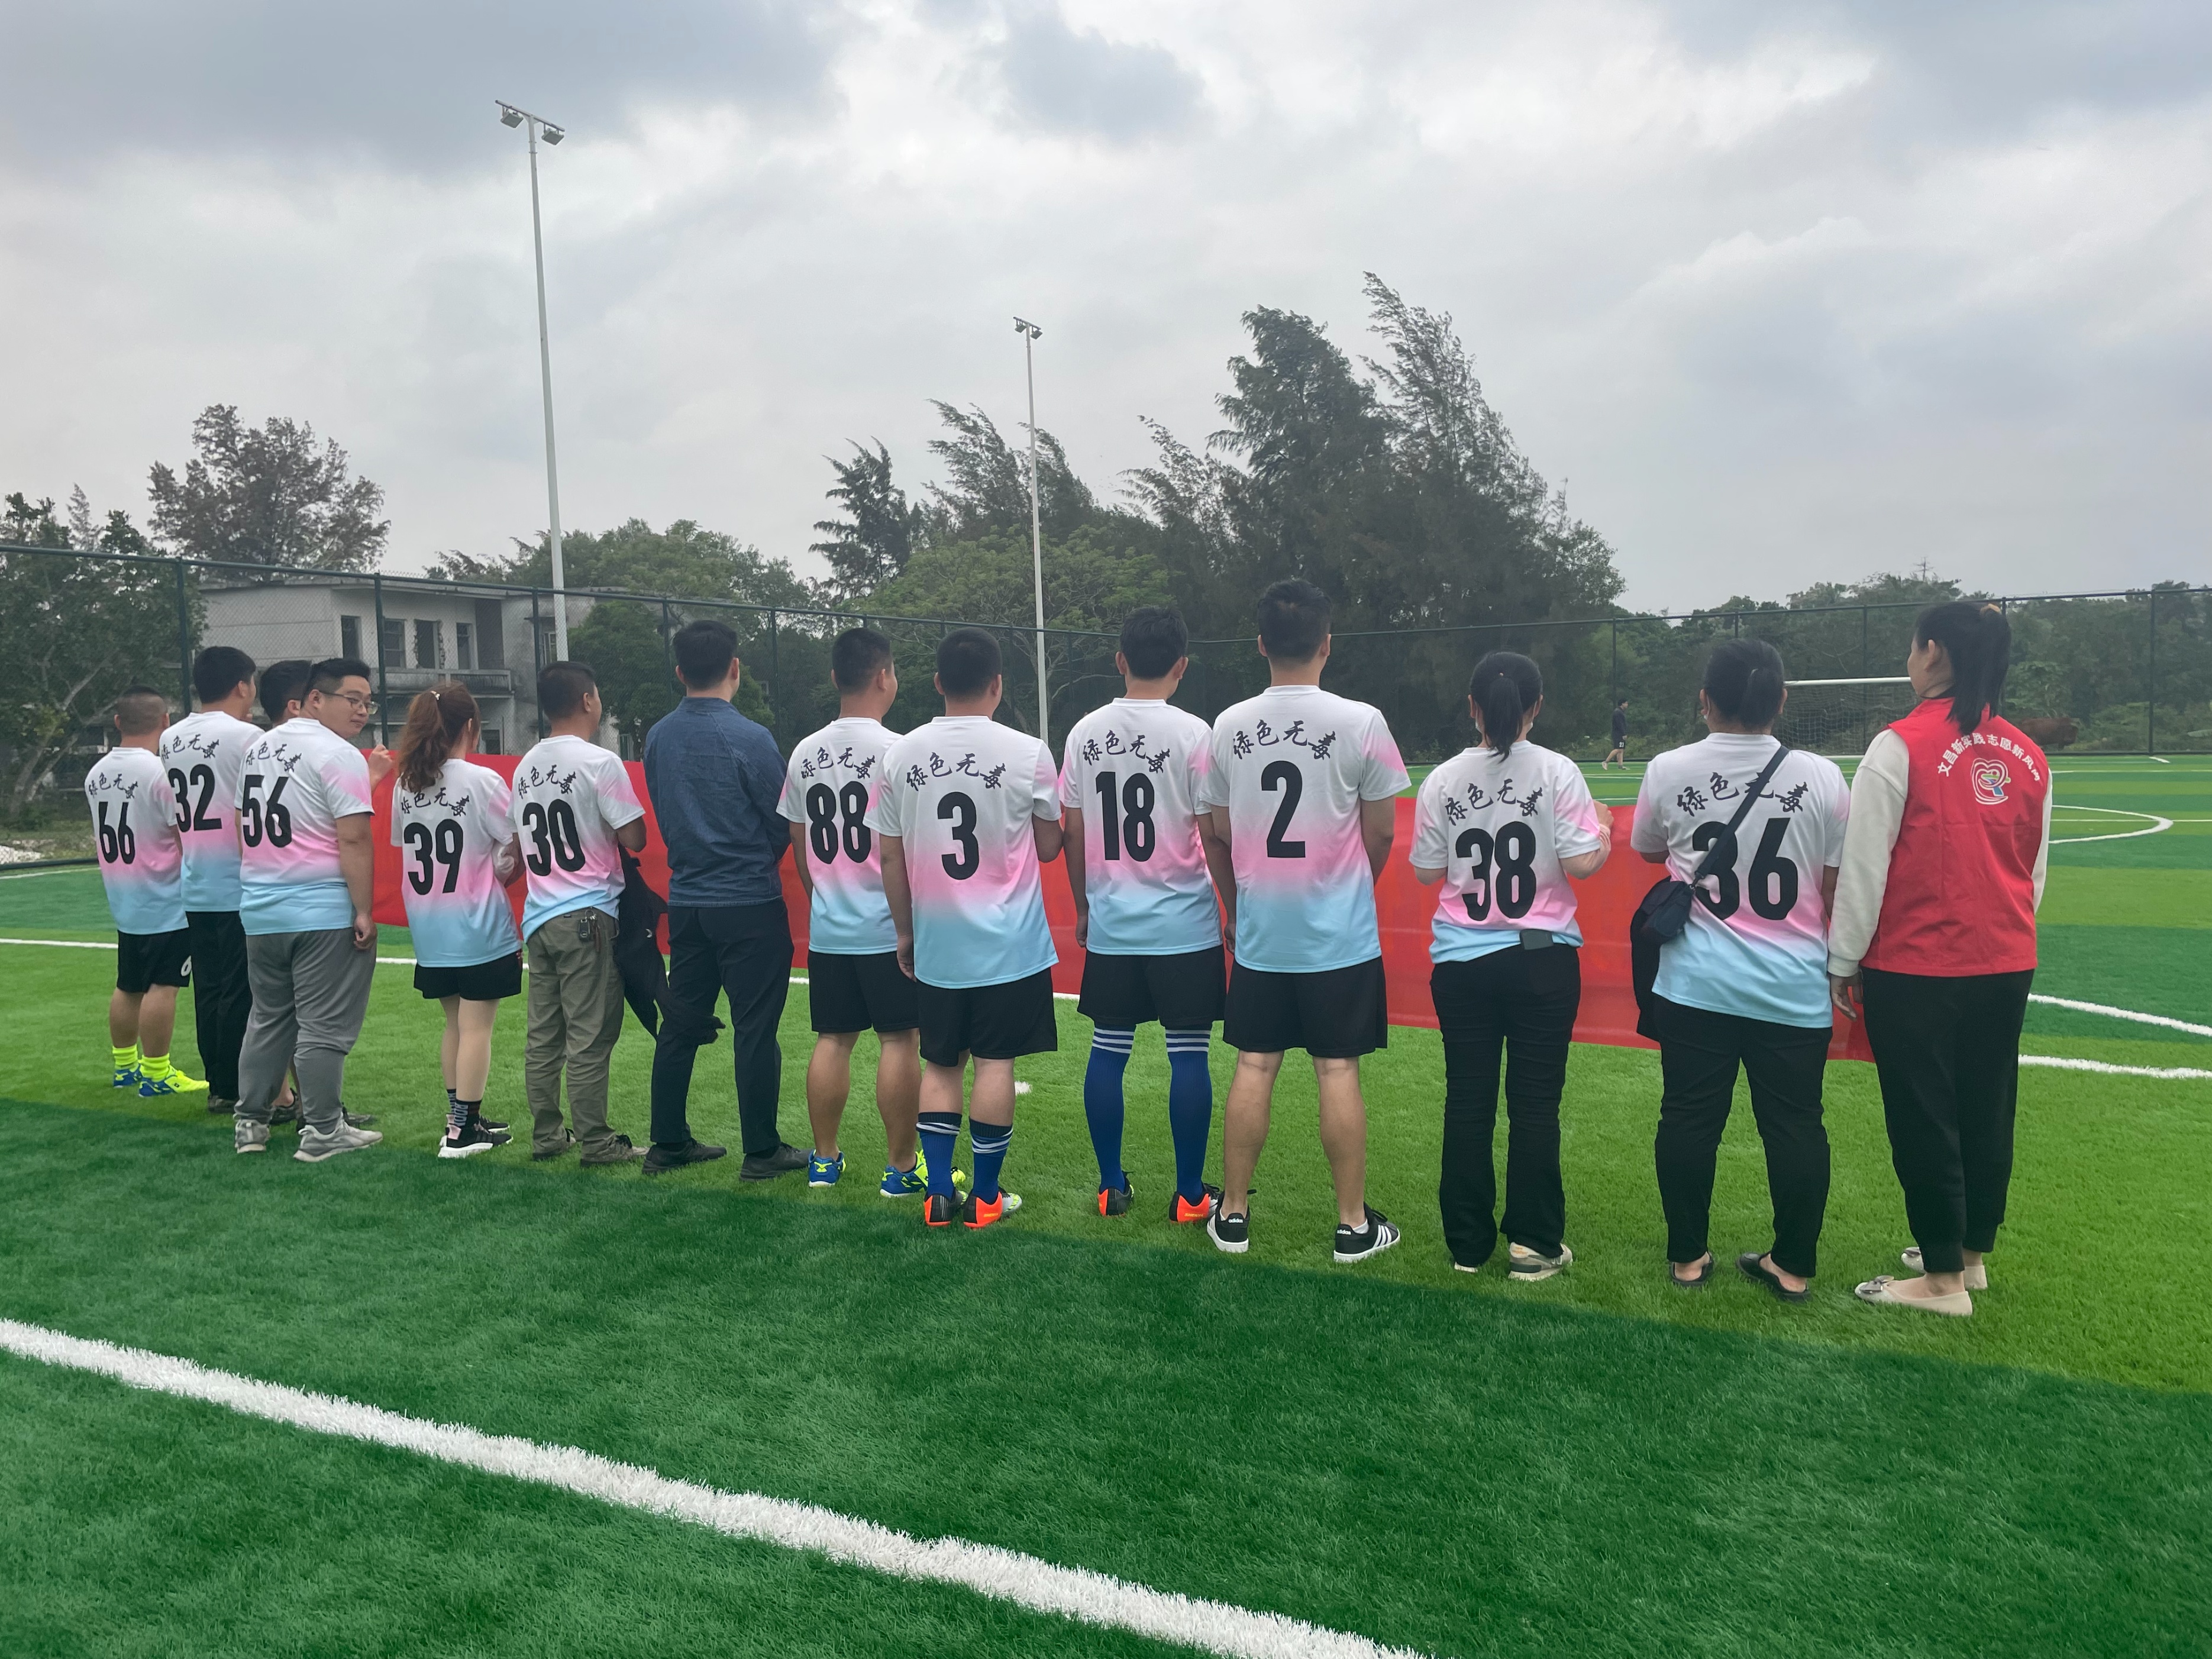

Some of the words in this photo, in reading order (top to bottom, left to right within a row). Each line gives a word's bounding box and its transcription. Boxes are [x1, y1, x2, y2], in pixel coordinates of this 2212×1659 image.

[98, 801, 135, 864] 66
[168, 764, 222, 832] 32
[243, 774, 292, 848] 56
[522, 799, 586, 876] 30
[806, 781, 871, 864] 88
[937, 791, 979, 880] 3
[1095, 771, 1155, 862] 18
[1261, 760, 1306, 858] 2
[403, 819, 463, 895] 39
[1455, 820, 1536, 921] 38
[1692, 818, 1798, 920] 36
